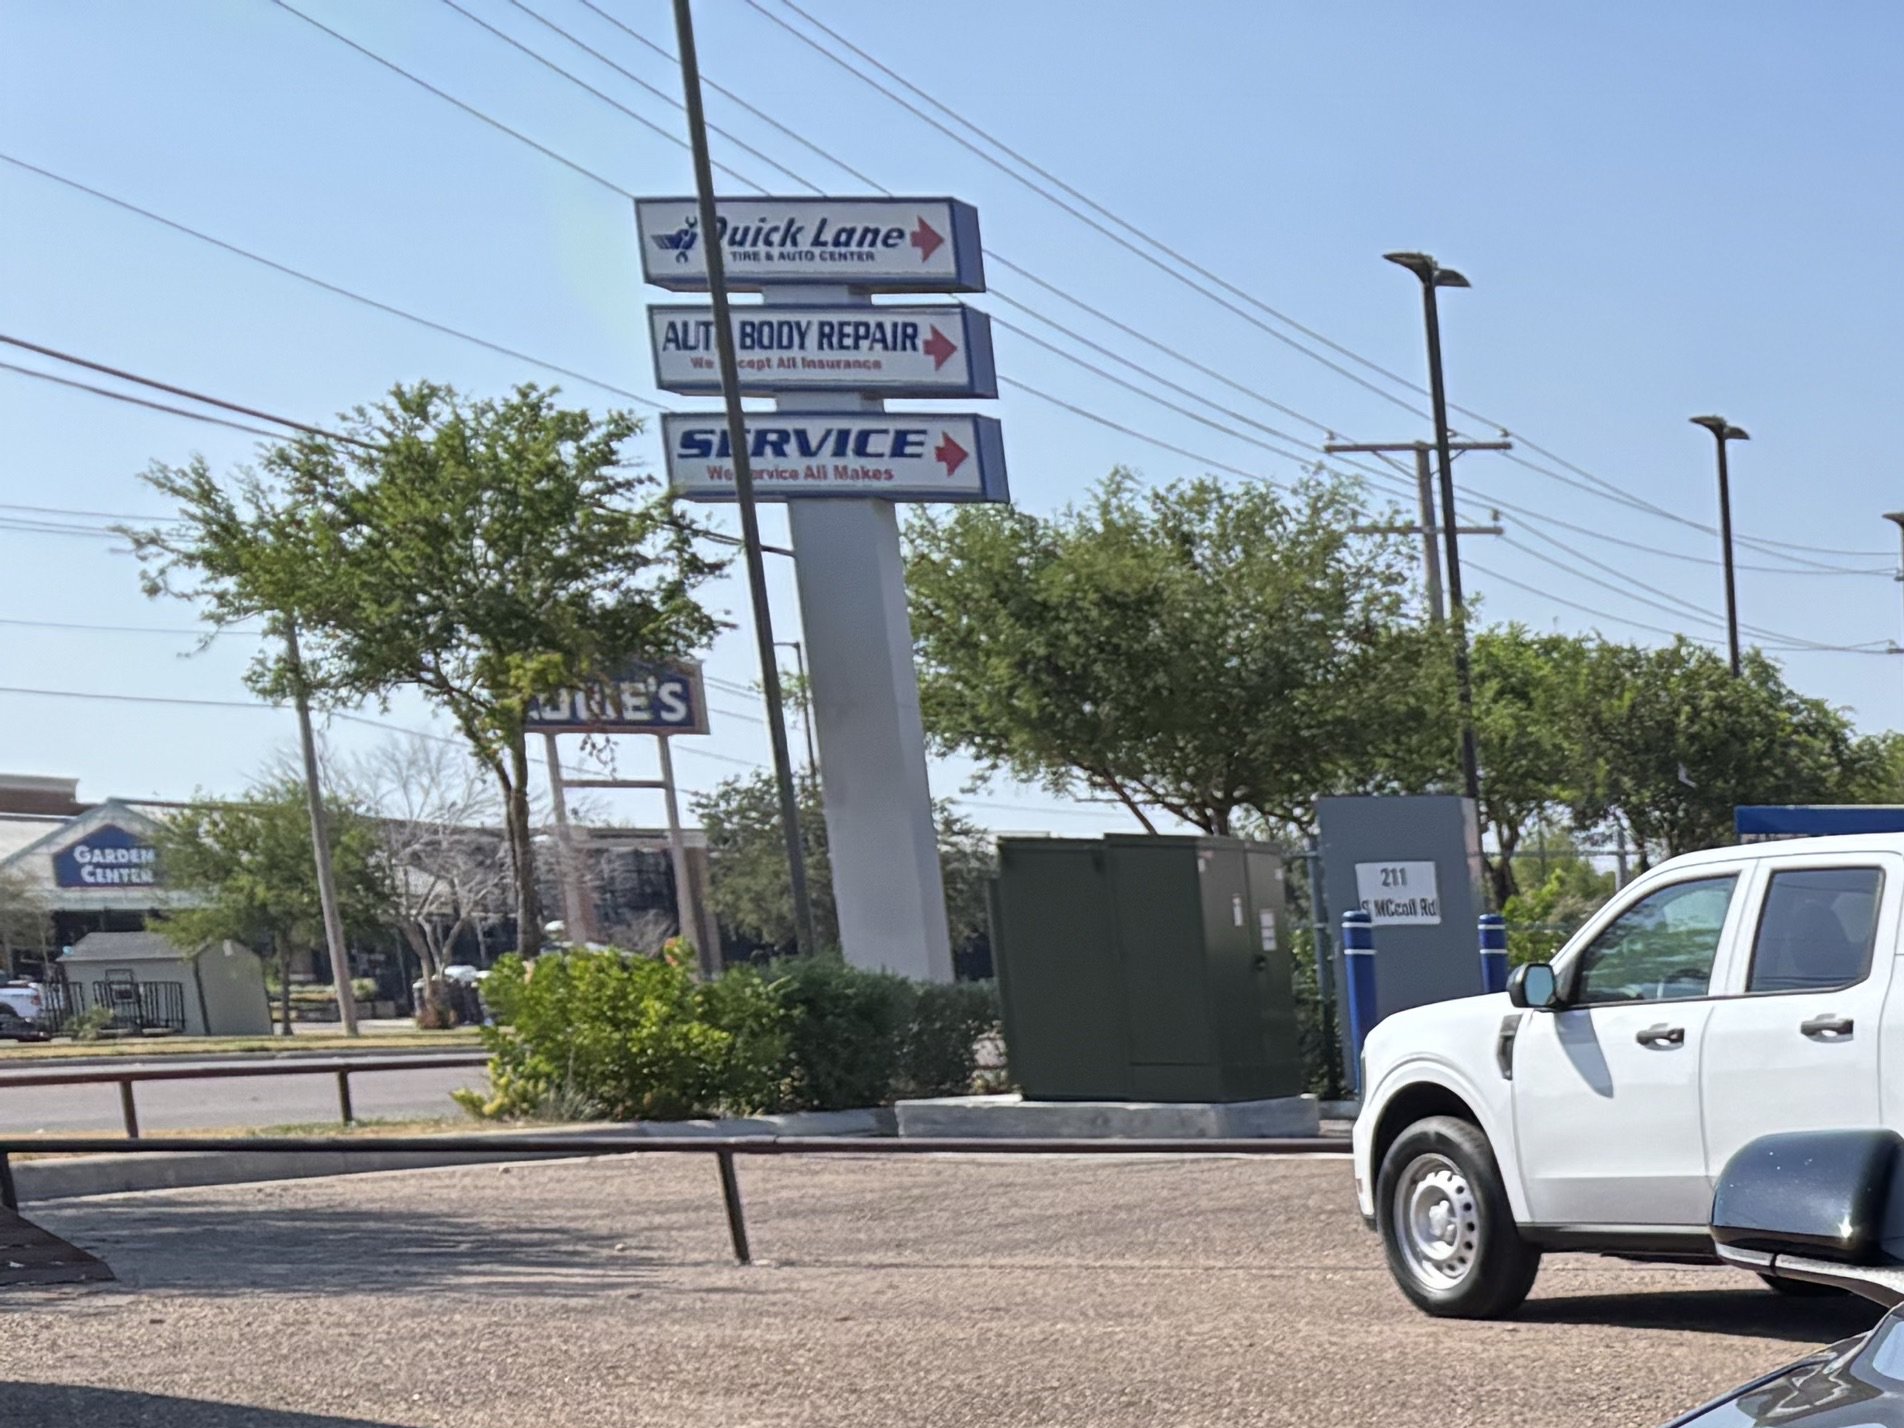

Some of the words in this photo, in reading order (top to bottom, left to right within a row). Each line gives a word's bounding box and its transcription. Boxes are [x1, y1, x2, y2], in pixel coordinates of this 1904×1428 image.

[810, 217, 905, 249] Lane
[731, 250, 761, 262] TIRE
[765, 250, 774, 262] &
[777, 250, 815, 262] AUTO
[819, 250, 875, 262] CENTER
[662, 320, 718, 352] AUT
[739, 320, 812, 351] BODY
[817, 320, 919, 352] REPAIR
[690, 356, 714, 370] We
[736, 357, 771, 373] cept
[777, 357, 796, 370] All
[801, 357, 882, 370] Insurance
[707, 465, 735, 481] We
[750, 465, 800, 481] ervice
[804, 465, 828, 481] All
[833, 465, 894, 481] Makes
[1380, 868, 1408, 888] 211
[1420, 898, 1437, 917] Rd
